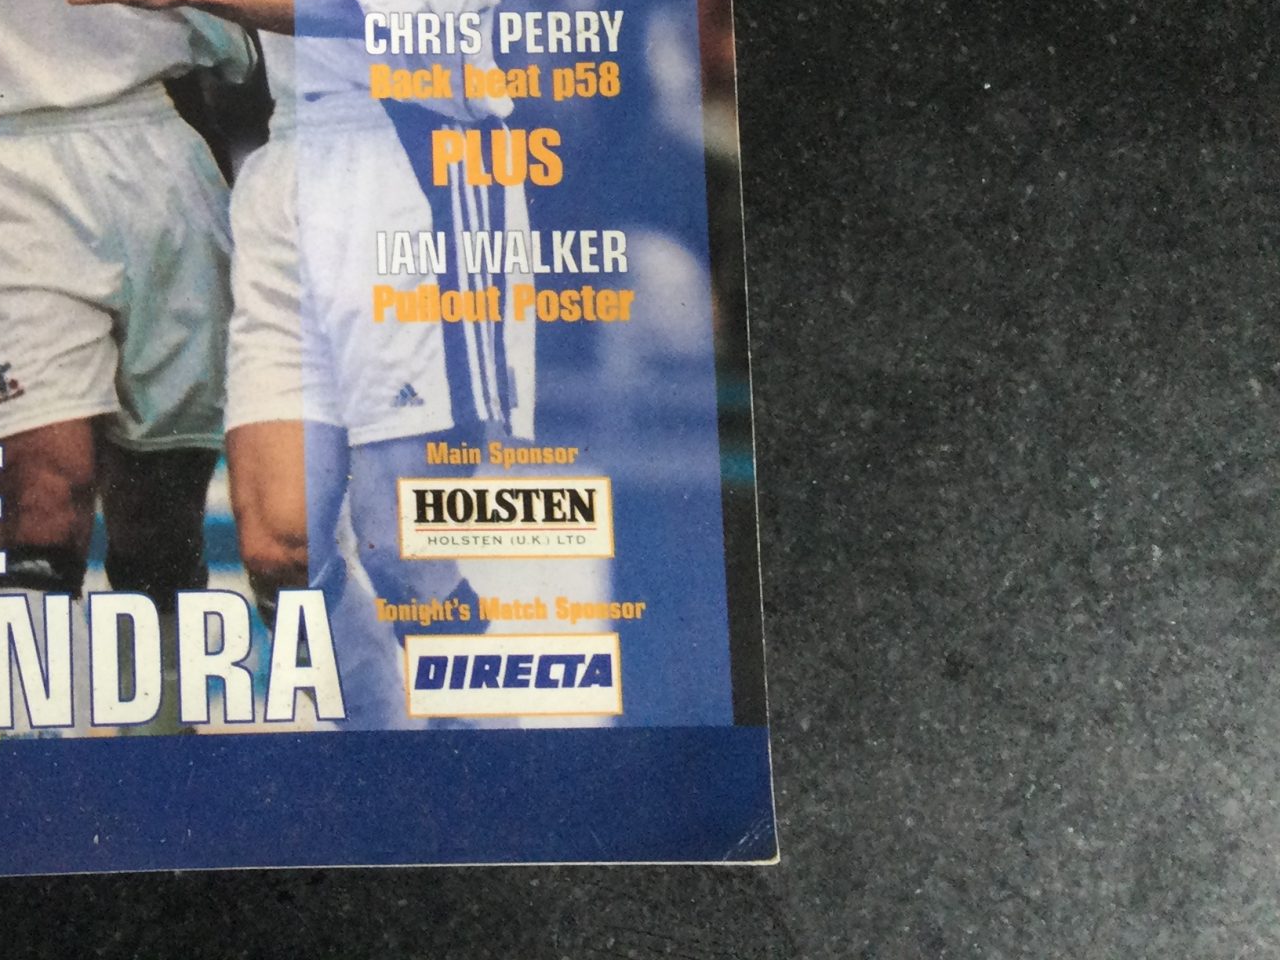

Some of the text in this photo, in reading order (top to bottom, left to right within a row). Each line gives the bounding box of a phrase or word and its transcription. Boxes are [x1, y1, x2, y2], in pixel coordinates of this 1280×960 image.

[364, 9, 625, 55] CHRIS PERRY
[371, 61, 621, 101] Back beat p58
[431, 128, 564, 187] PLUS
[376, 230, 629, 276] IAN WALKER
[372, 283, 635, 323] Pullout Poster
[426, 441, 579, 469] Main Sponsor
[412, 488, 596, 524] HOLSTEN
[427, 535, 503, 546] HOLSTEN
[557, 534, 587, 545] LTD
[375, 596, 646, 626] Tonight's Match Sponsor
[414, 653, 613, 691] DIRECTA
